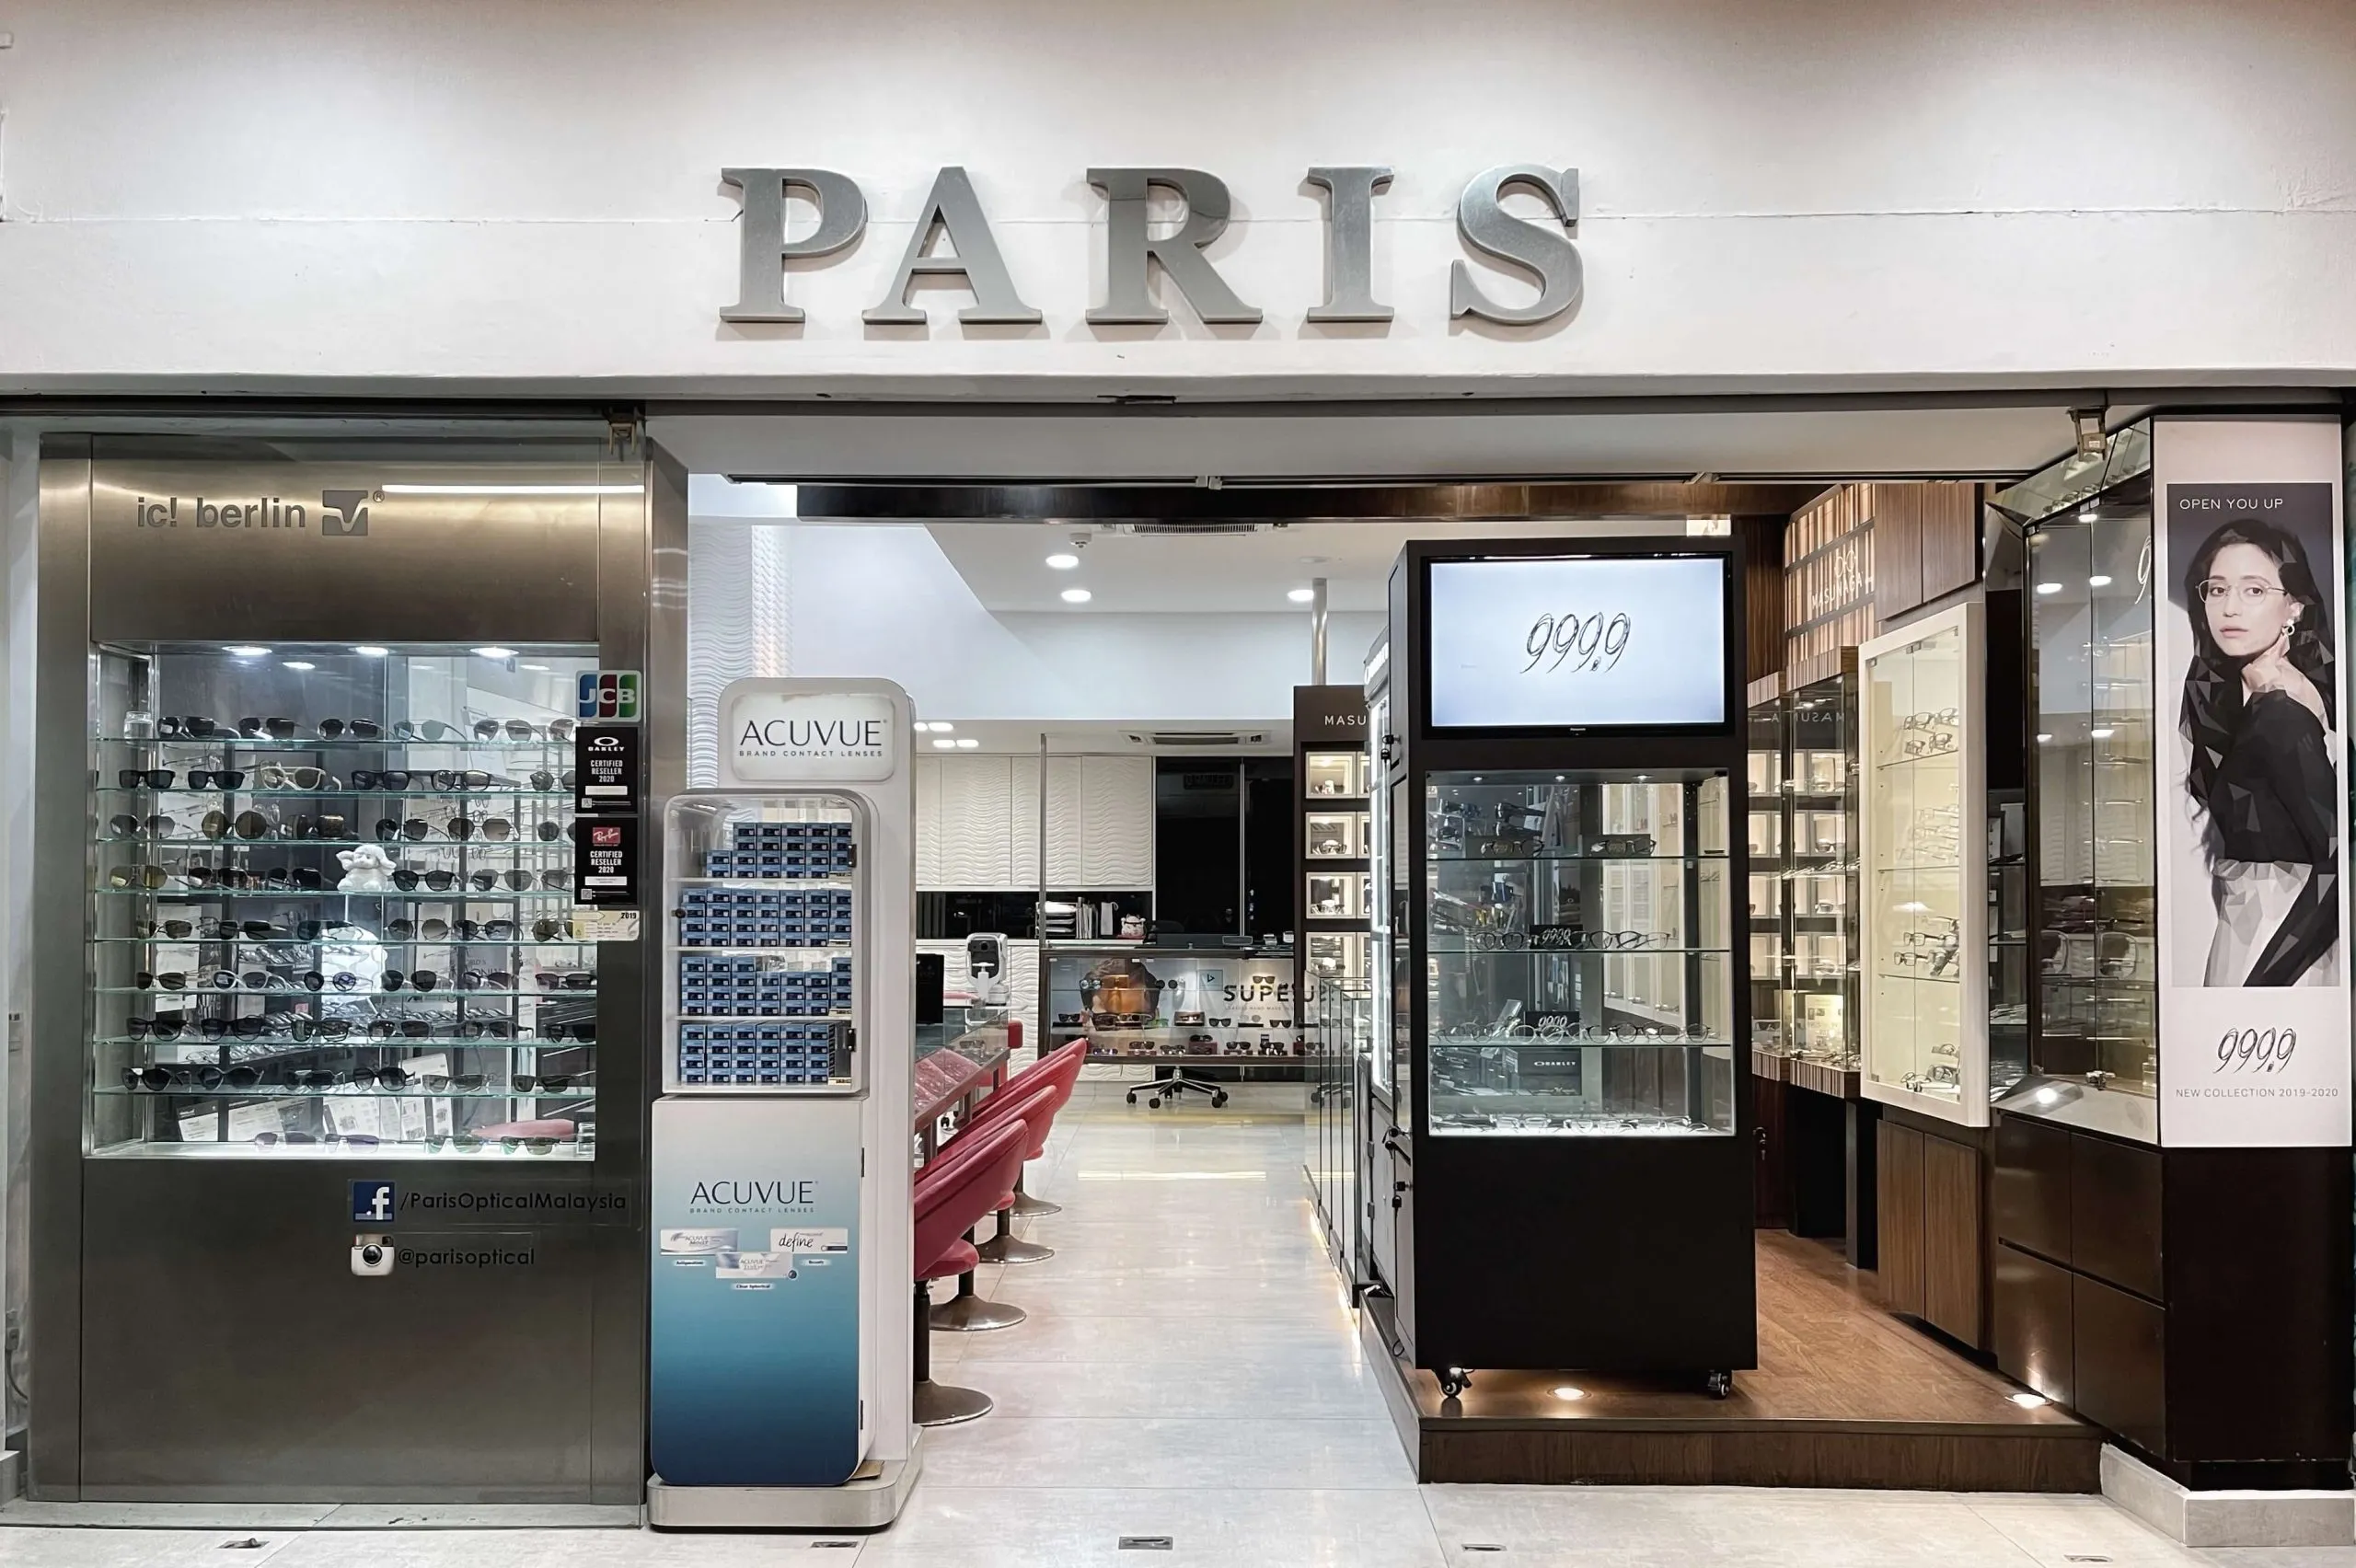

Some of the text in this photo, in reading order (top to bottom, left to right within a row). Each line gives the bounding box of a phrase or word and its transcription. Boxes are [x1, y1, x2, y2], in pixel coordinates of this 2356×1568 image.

[719, 163, 1583, 326] PARIS
[137, 497, 306, 528] ic! berlin
[2179, 498, 2283, 510] OPEN YOU UP
[1811, 571, 1863, 610] MASUNAGA
[1519, 611, 1632, 674] 999.9
[579, 688, 636, 704] JCB
[740, 720, 882, 746] ACUVUE
[590, 759, 623, 767] CERTIFIED
[590, 850, 623, 859] CERTIFIED
[2212, 1027, 2297, 1074] 999.9
[2176, 1088, 2339, 1098] NEW COLLECTION 2019-2020
[399, 1192, 626, 1213] /ParisOpticalMalaysia
[690, 1181, 814, 1205] ACUVUE
[779, 1232, 814, 1252] define
[398, 1248, 535, 1268] @parisoptical
